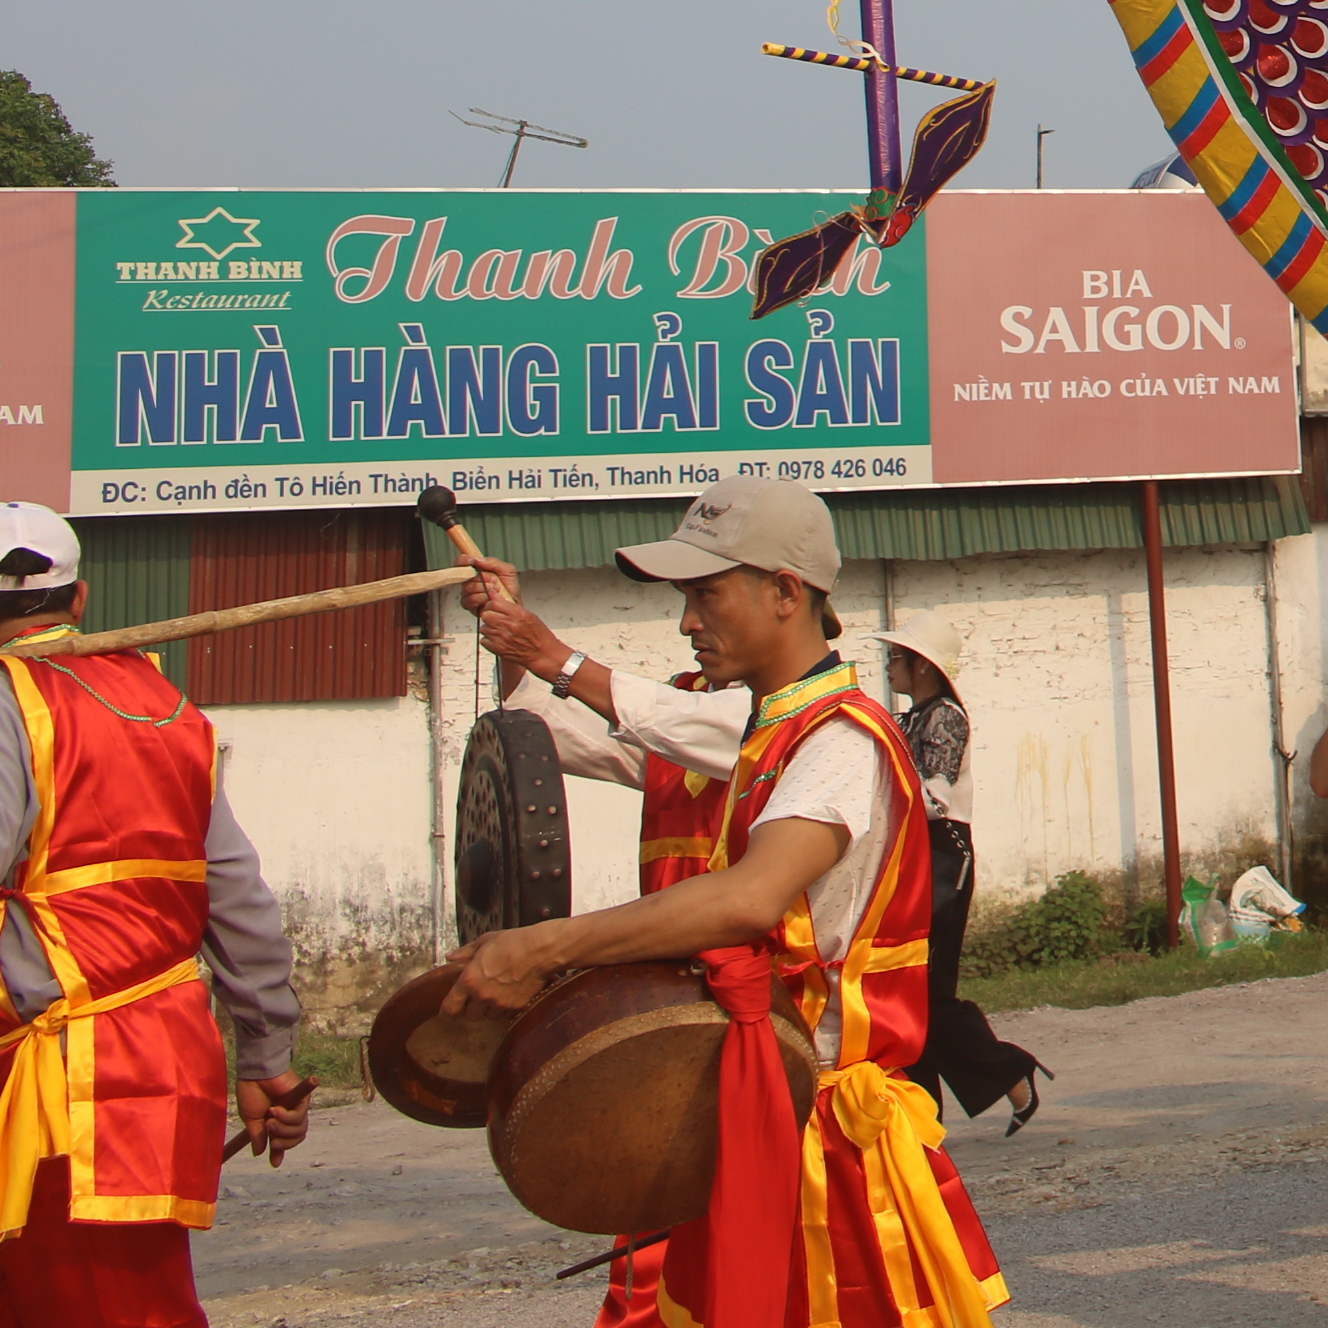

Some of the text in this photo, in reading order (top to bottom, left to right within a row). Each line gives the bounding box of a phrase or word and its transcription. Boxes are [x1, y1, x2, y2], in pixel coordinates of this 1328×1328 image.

[116, 257, 303, 280] THANH BÌNH
[326, 214, 643, 304] Thanh
[142, 289, 292, 310] Restaurant
[1082, 269, 1153, 300] BIA
[1000, 305, 1232, 354] SAIGON
[115, 308, 900, 447] NHÀ HÀNG HẢI SẢN
[953, 372, 1281, 404] NIỀM TỰ HÀO CỦA VIỆT NAM
[102, 456, 907, 506] ĐC: Cạnh đền Tô Hiến Thành Biển Hải Tiến, Thanh Hóa ĐT: 0978 426 046
